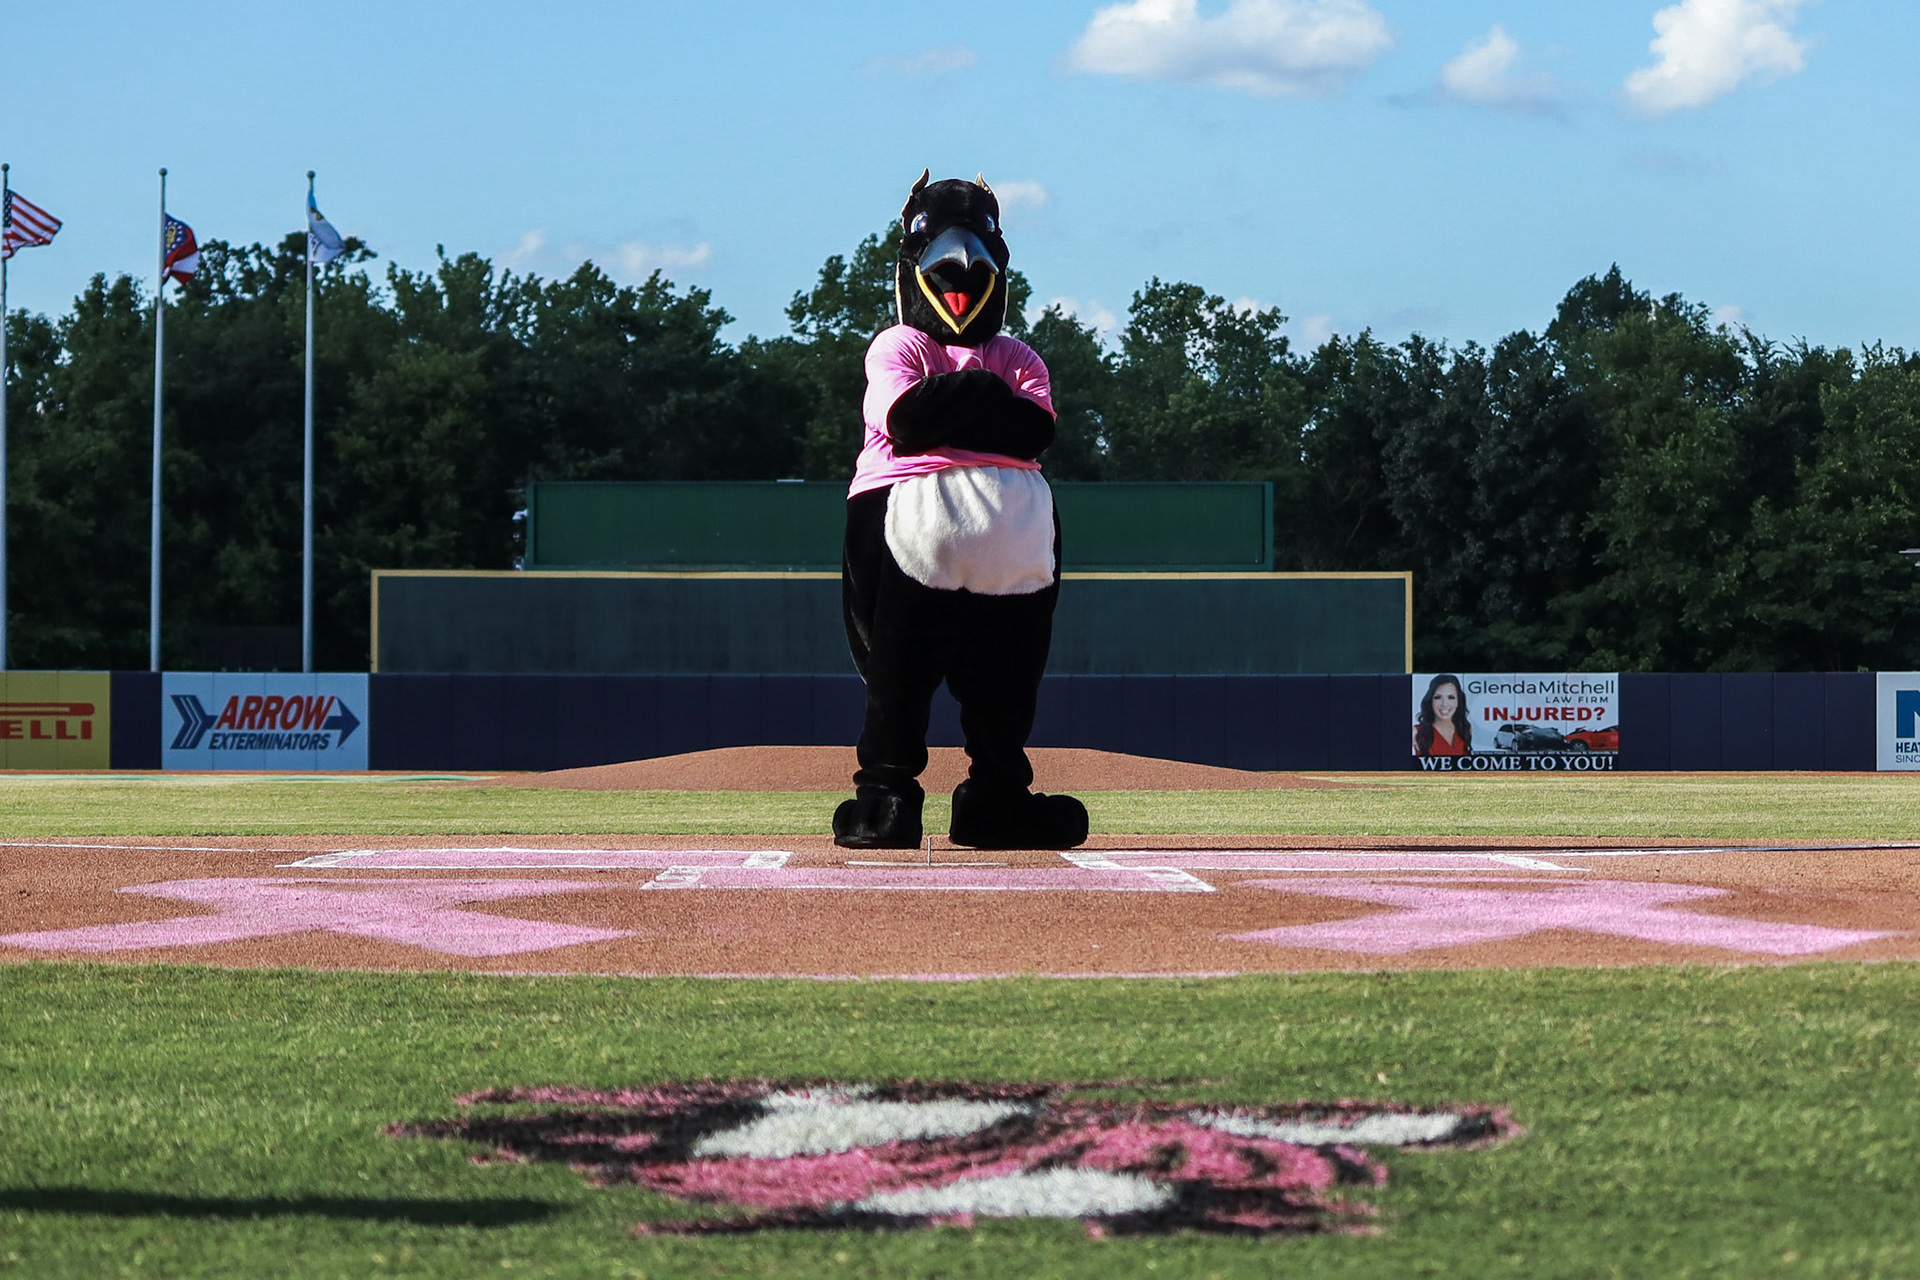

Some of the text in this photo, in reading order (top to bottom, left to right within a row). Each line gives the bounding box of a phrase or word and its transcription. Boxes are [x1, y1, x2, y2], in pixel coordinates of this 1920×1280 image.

[1545, 696, 1609, 704] LAW FIRM
[215, 694, 336, 731] ARROW
[1484, 707, 1606, 721] INJURED?
[208, 733, 331, 751] EXTERMINATORS
[1418, 756, 1614, 771] WE COME TO YOU!
